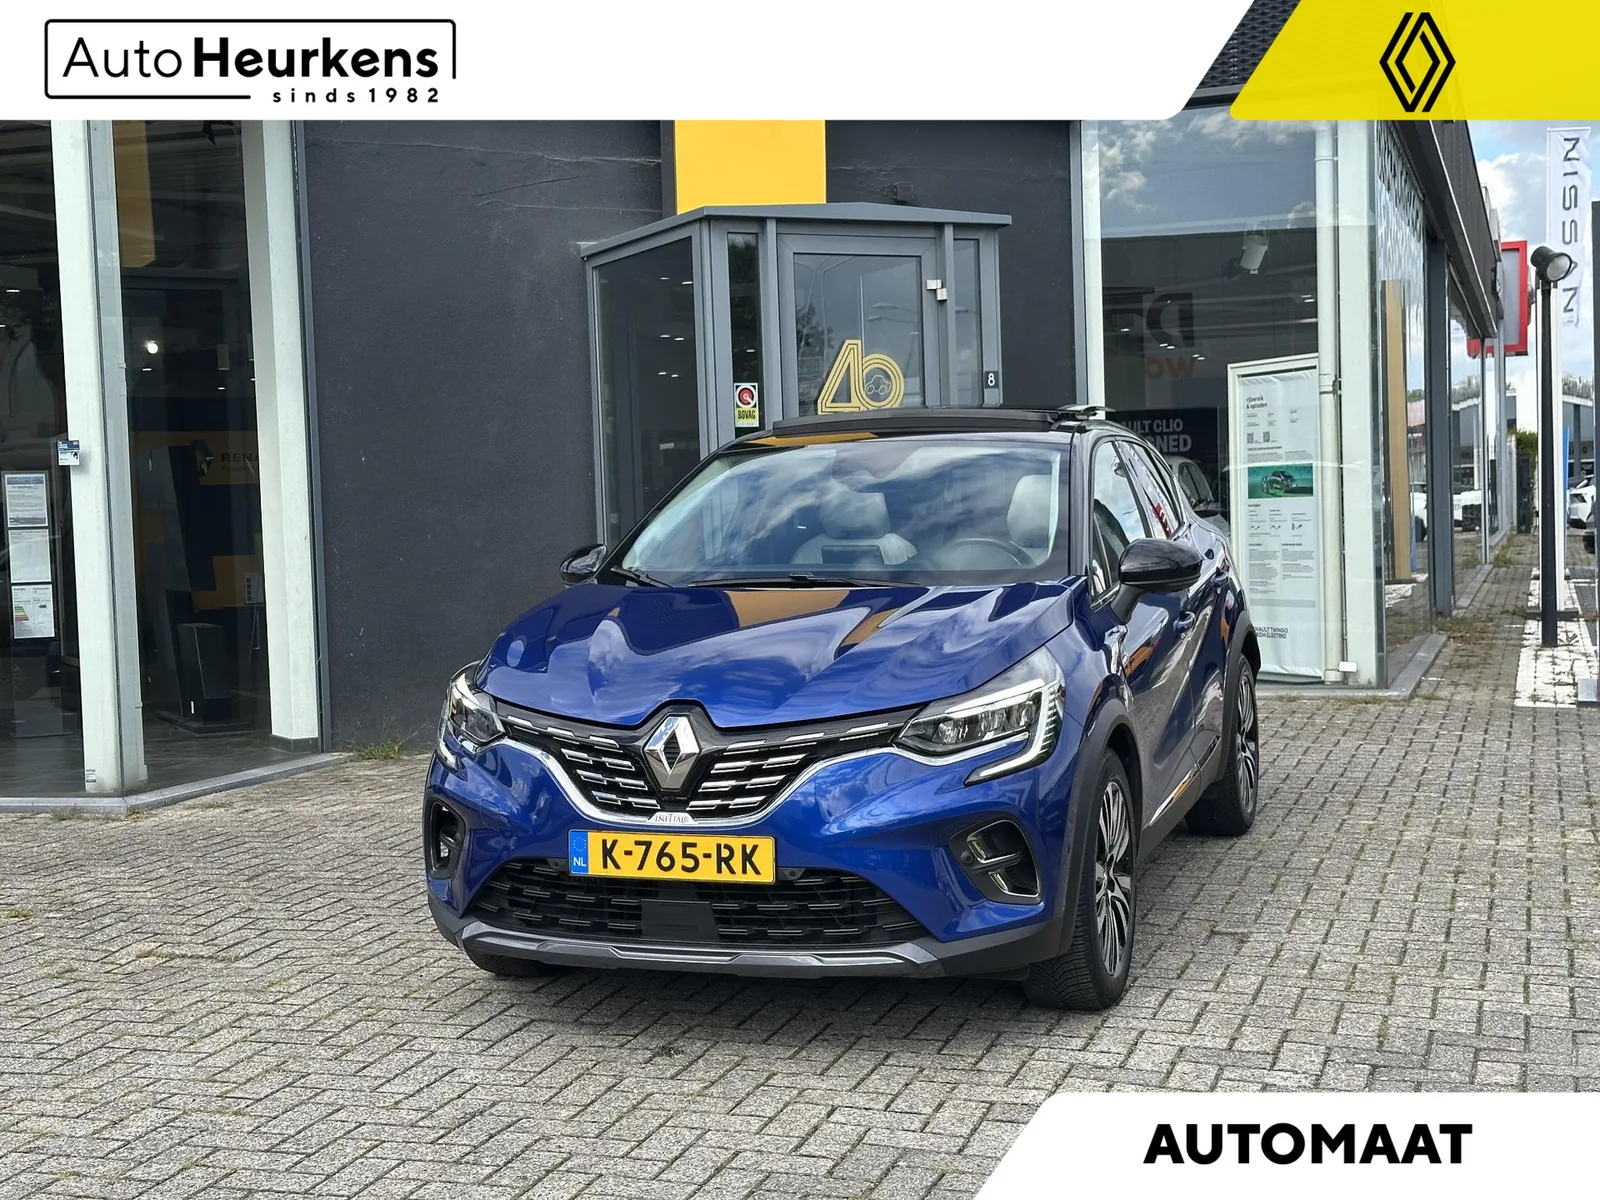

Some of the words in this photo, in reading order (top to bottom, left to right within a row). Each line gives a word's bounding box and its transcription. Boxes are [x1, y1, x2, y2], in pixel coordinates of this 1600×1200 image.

[987, 372, 996, 387] 8
[737, 410, 756, 420] BOVAG
[1153, 418, 1183, 433] CLIO
[573, 856, 587, 867] NL
[601, 838, 761, 876] K-765-RK
